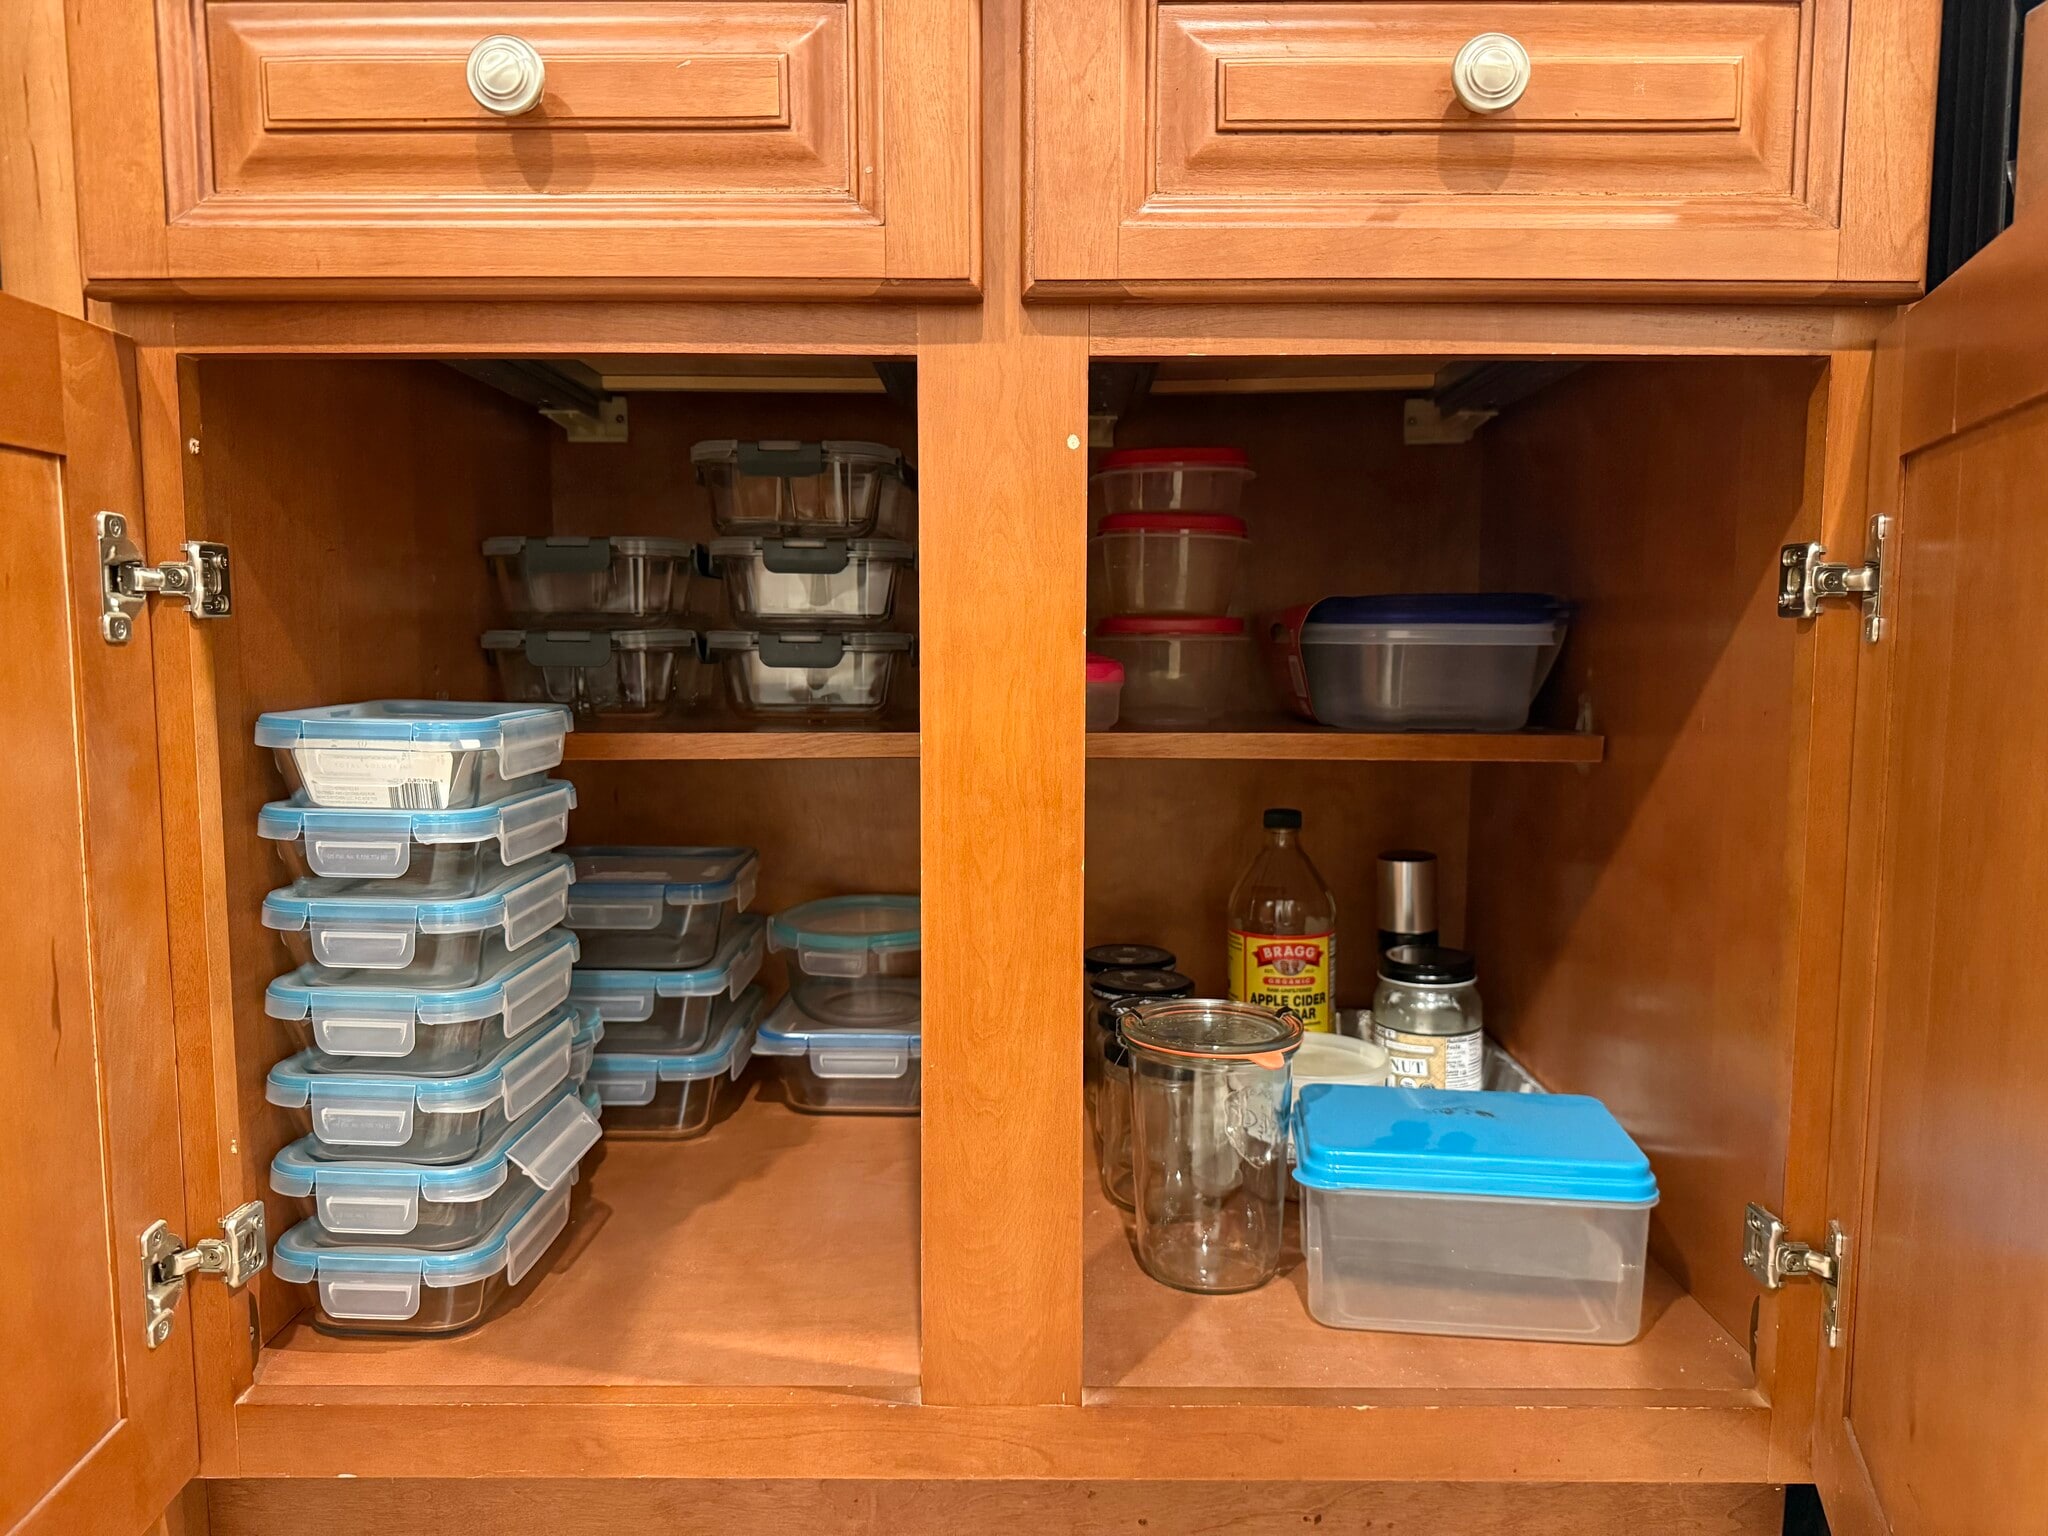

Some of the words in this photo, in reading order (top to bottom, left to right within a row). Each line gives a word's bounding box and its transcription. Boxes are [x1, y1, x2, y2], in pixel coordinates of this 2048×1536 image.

[1262, 945, 1316, 958] BRAGG
[1267, 977, 1311, 985] ORGANIC
[1250, 992, 1289, 1007] APPLE
[1293, 992, 1326, 1007] CIDER
